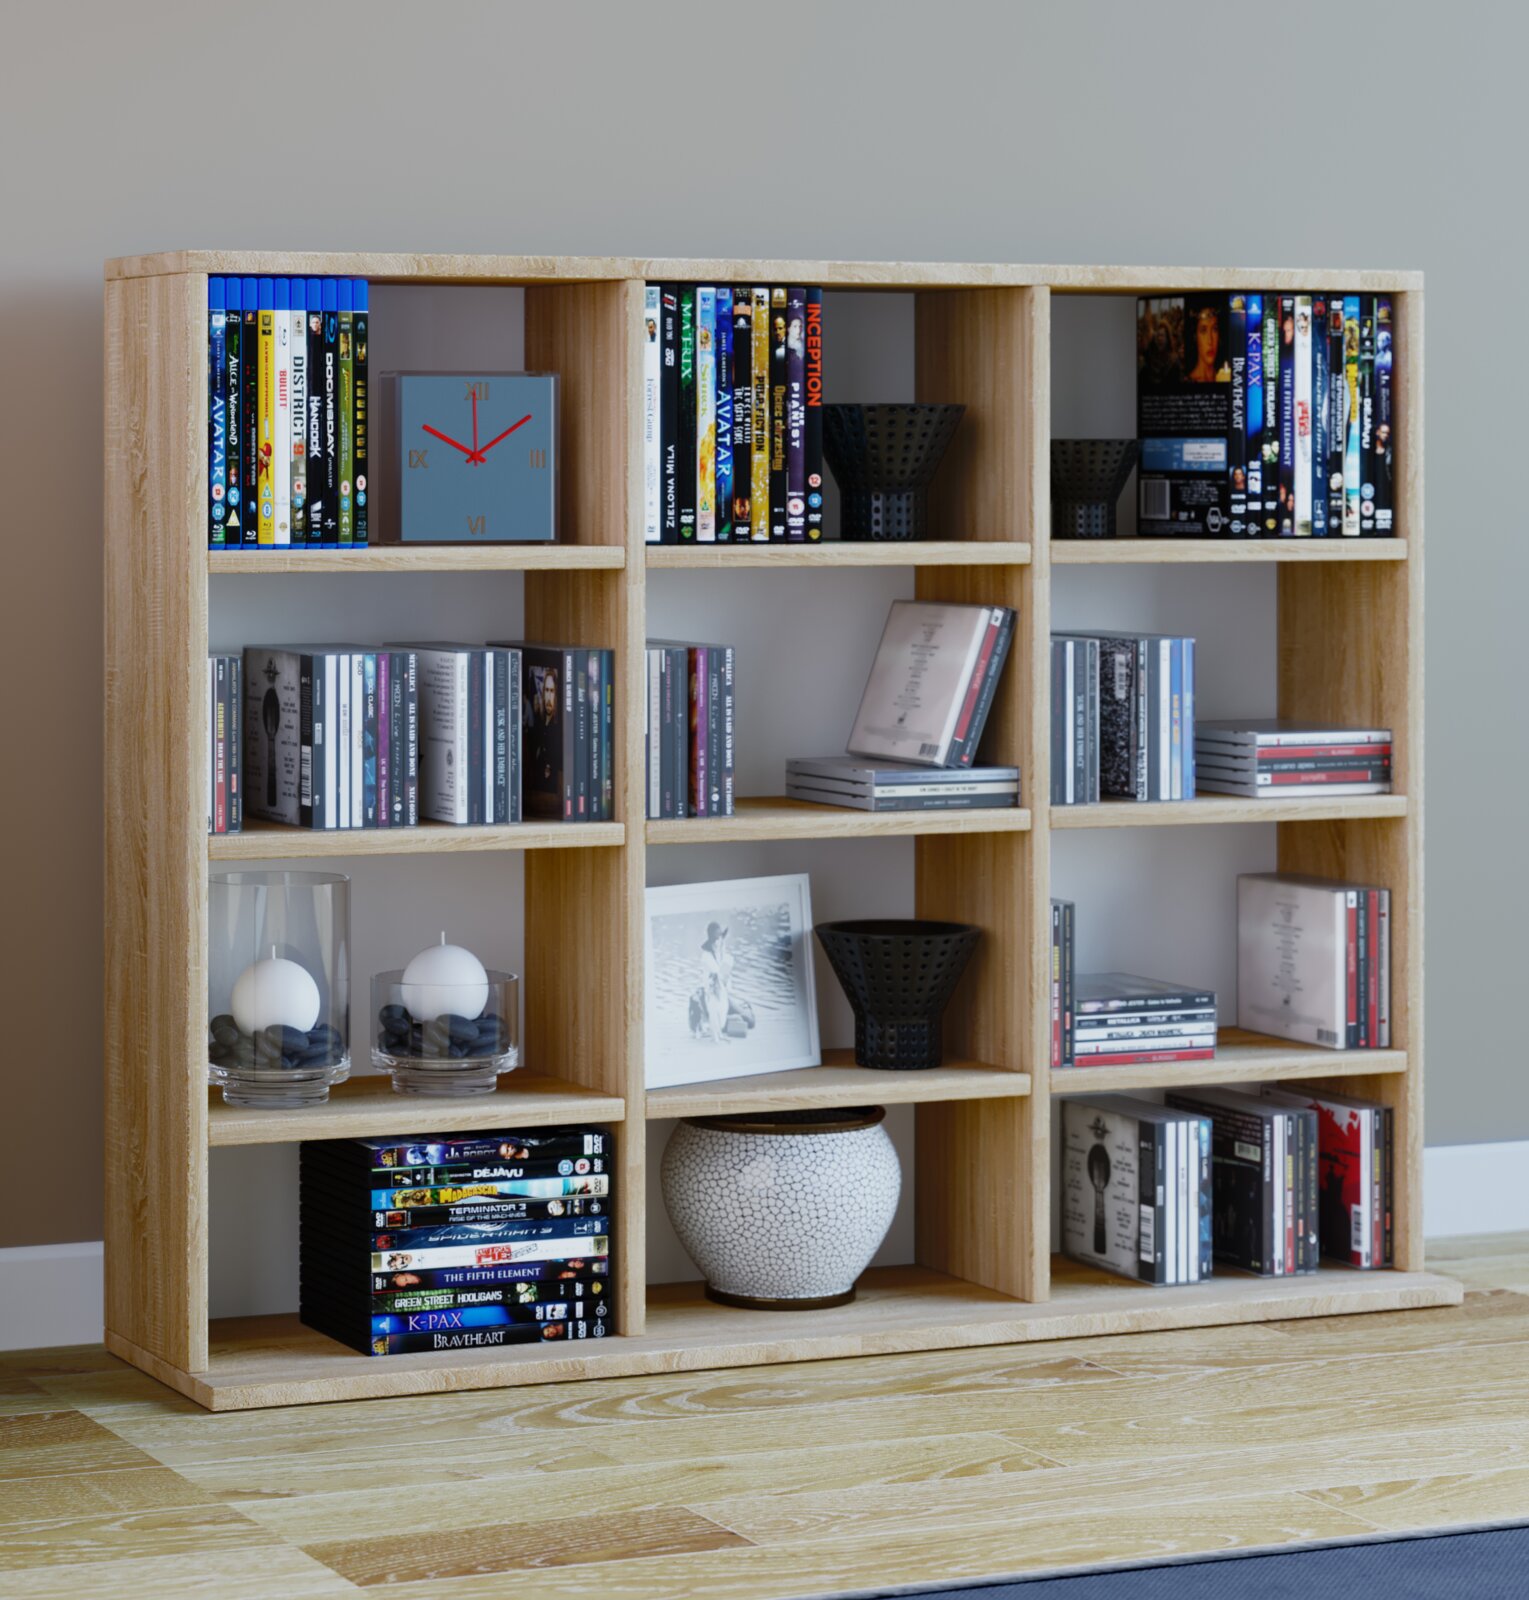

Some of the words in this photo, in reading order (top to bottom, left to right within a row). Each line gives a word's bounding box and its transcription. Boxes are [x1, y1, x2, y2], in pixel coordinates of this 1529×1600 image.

[680, 303, 693, 380] MATRIX
[1266, 318, 1275, 346] GREEN
[229, 352, 239, 386] ALICE
[807, 303, 821, 407] INCEPTION
[1247, 332, 1260, 387] K-PAX
[1266, 348, 1275, 379] STREET
[464, 382, 490, 400] XII
[700, 363, 710, 417] SHREK
[755, 376, 764, 404] PULP
[1283, 368, 1291, 389] THE
[293, 356, 305, 439] DISTRICT
[325, 352, 334, 457] DOOMSDAY
[646, 378, 655, 411] Forrest
[772, 385, 786, 417] Ojciec
[1232, 357, 1244, 431] BRAVEHEART
[1266, 381, 1275, 428] HOOLIGANS
[1283, 391, 1291, 419] FIFTH
[1335, 374, 1343, 439] TERMINATOR
[310, 396, 321, 458] HANCOCK
[646, 413, 655, 443] Gump
[755, 407, 764, 452] FICTION
[791, 382, 800, 448] PIANIST
[213, 396, 225, 480] AVATAR
[716, 390, 731, 478] AVATAR
[1283, 421, 1291, 467] ELEMENT
[1335, 442, 1342, 452] 3
[293, 443, 304, 456] 9
[409, 449, 429, 469] IX
[529, 448, 546, 469] III
[666, 444, 675, 474] MILA
[810, 477, 819, 485] 12
[666, 477, 675, 528] ZIELONA
[467, 515, 486, 535] VI
[409, 715, 415, 723] IS
[497, 728, 505, 741] AND
[497, 742, 505, 756] HER
[439, 1185, 497, 1204] MADAGASCAR
[449, 1203, 516, 1215] TERMINATOR
[519, 1203, 527, 1211] 3
[491, 1212, 527, 1220] MACHINES
[444, 1273, 464, 1283] THE
[466, 1271, 494, 1281] FIFTH
[497, 1268, 541, 1279] ELEMENT
[394, 1298, 422, 1309] GREEN
[424, 1294, 454, 1306] STREET
[458, 1290, 503, 1303] HOOLIGANS
[409, 1312, 463, 1331] K-PAX
[433, 1331, 506, 1348] BRAVEHEART
